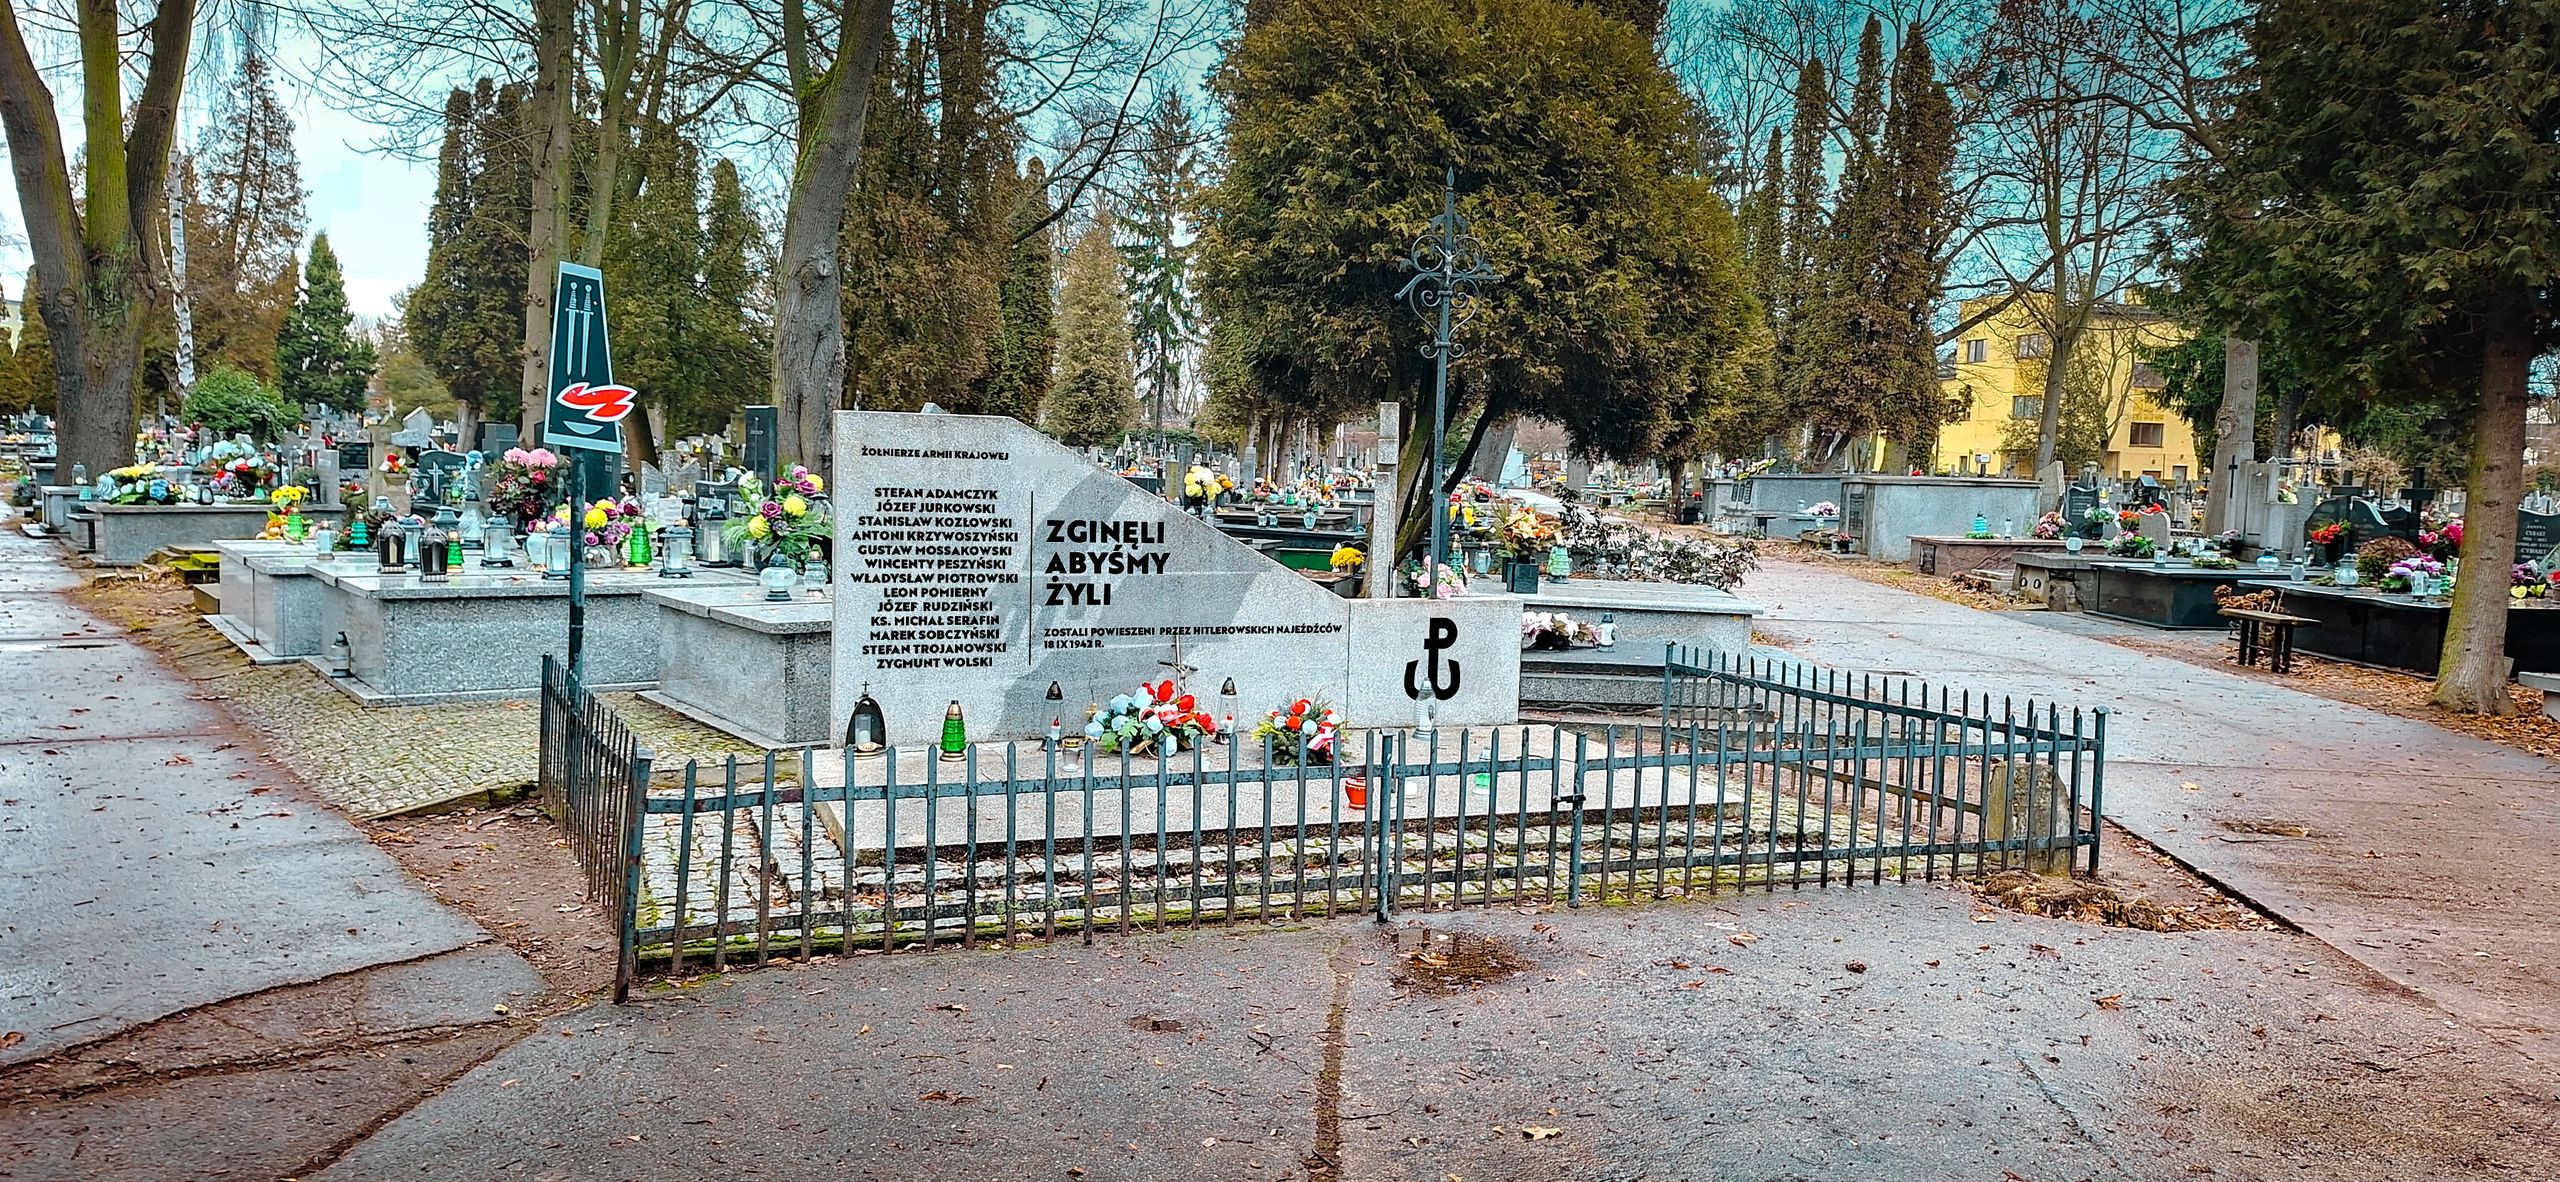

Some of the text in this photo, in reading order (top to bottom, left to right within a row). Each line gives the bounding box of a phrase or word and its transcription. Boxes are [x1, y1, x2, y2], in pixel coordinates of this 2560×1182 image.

[862, 446, 1009, 460] ŻOŁNIERZE ARMII KRAJOWEJ
[875, 488, 997, 500] STEFAN ADAMCZYK
[877, 499, 995, 513] JÓZEF JURKOWSKI
[859, 516, 1012, 528] STANISŁAW KOZŁOWSKI
[852, 529, 1018, 542] ANTONI KRZYWOSZYŃSKI
[1045, 520, 1165, 551] ZGINĘLI
[858, 545, 1012, 556] GUSTAW MOSSAKOWSKI
[865, 557, 1005, 569] WINCENTY PESZYŃSKI
[1045, 544, 1170, 574] ABYŚMY
[851, 573, 1018, 583] WŁADYSŁAW PIOTROWSKI
[884, 588, 988, 597] LEON POMIERNY
[1045, 576, 1111, 606] ŻYLI
[878, 599, 992, 612] JÓZEF RUDZIŃSKI
[871, 615, 999, 626] KS. MICHAŁ SERAFIN
[870, 627, 999, 640] MAREK SOBCZYŃSKI
[1044, 623, 1342, 637] ZOSTALI POWIESZENI PRZEZ HITLEROWSKICH NAJEŹDŹCÓW
[862, 643, 1006, 654] STEFAN TROJANOWSKI
[1044, 640, 1055, 648] 18
[1057, 640, 1069, 648] IX
[1095, 640, 1104, 648] R.
[877, 657, 992, 669] ZYGMUNT WOLSKI
